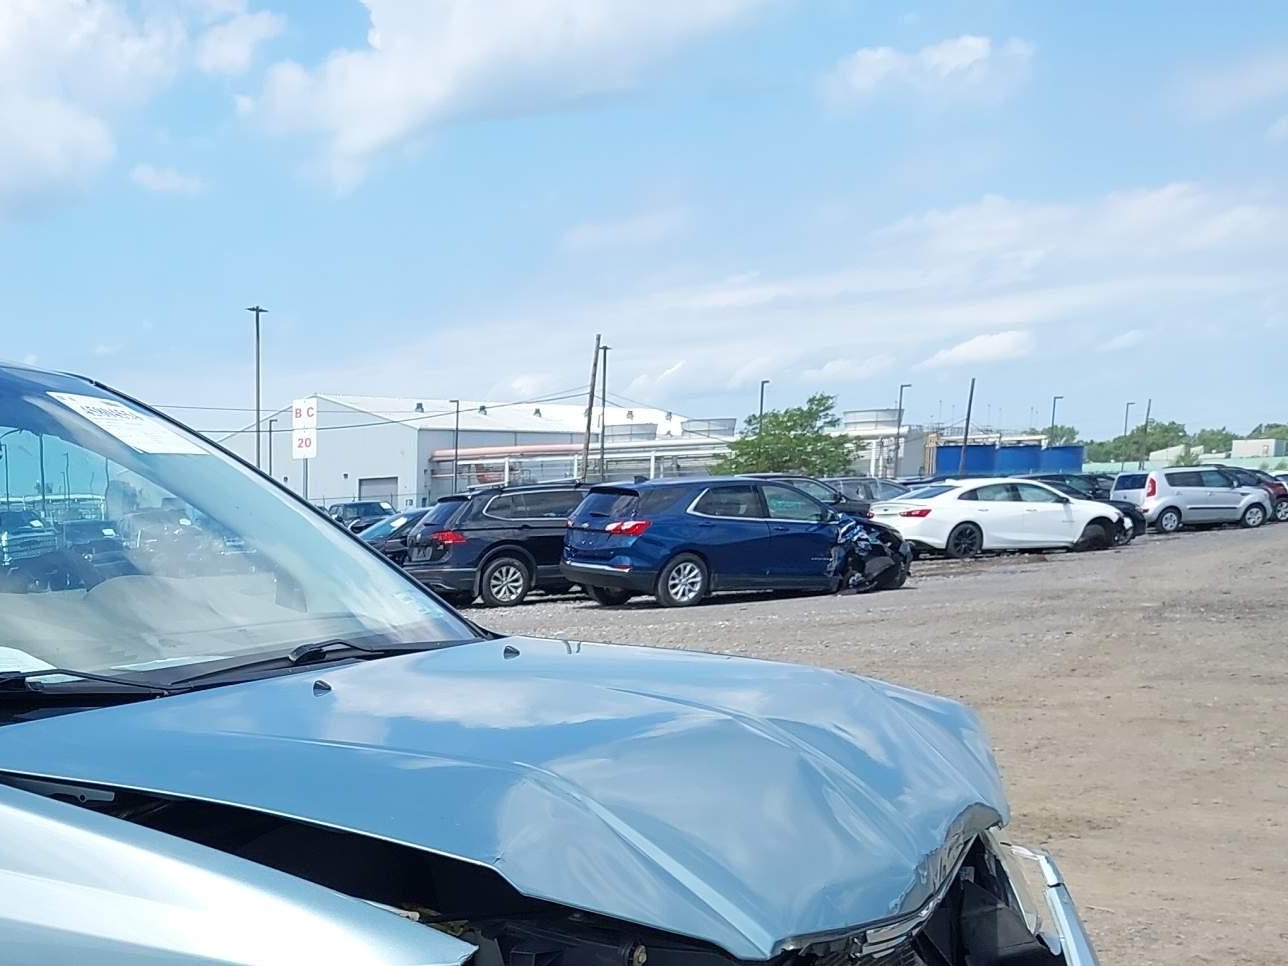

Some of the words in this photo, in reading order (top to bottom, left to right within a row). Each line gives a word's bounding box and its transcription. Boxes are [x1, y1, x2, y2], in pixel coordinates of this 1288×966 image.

[295, 408, 302, 418] B
[306, 407, 314, 417] C
[297, 438, 312, 448] 20
